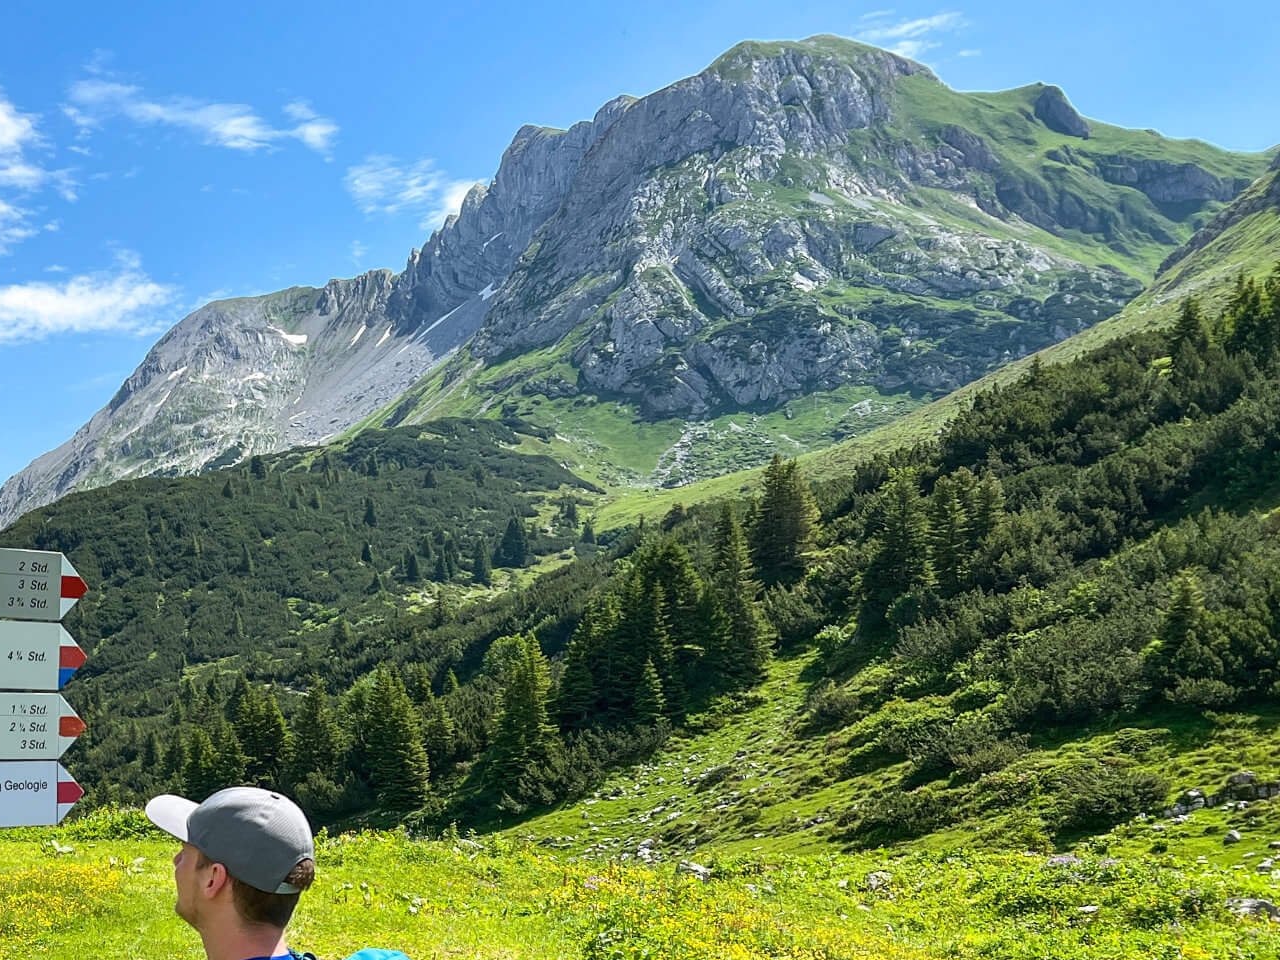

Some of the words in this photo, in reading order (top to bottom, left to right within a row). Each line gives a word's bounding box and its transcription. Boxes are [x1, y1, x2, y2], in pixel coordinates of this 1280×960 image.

[30, 561, 49, 574] Std.
[30, 580, 49, 591] Std.
[29, 597, 49, 609] Std.
[27, 650, 47, 662] Std.
[29, 704, 48, 715] Std.
[28, 721, 48, 733] Std.
[28, 739, 47, 750] Std.
[4, 779, 48, 793] Geologie
